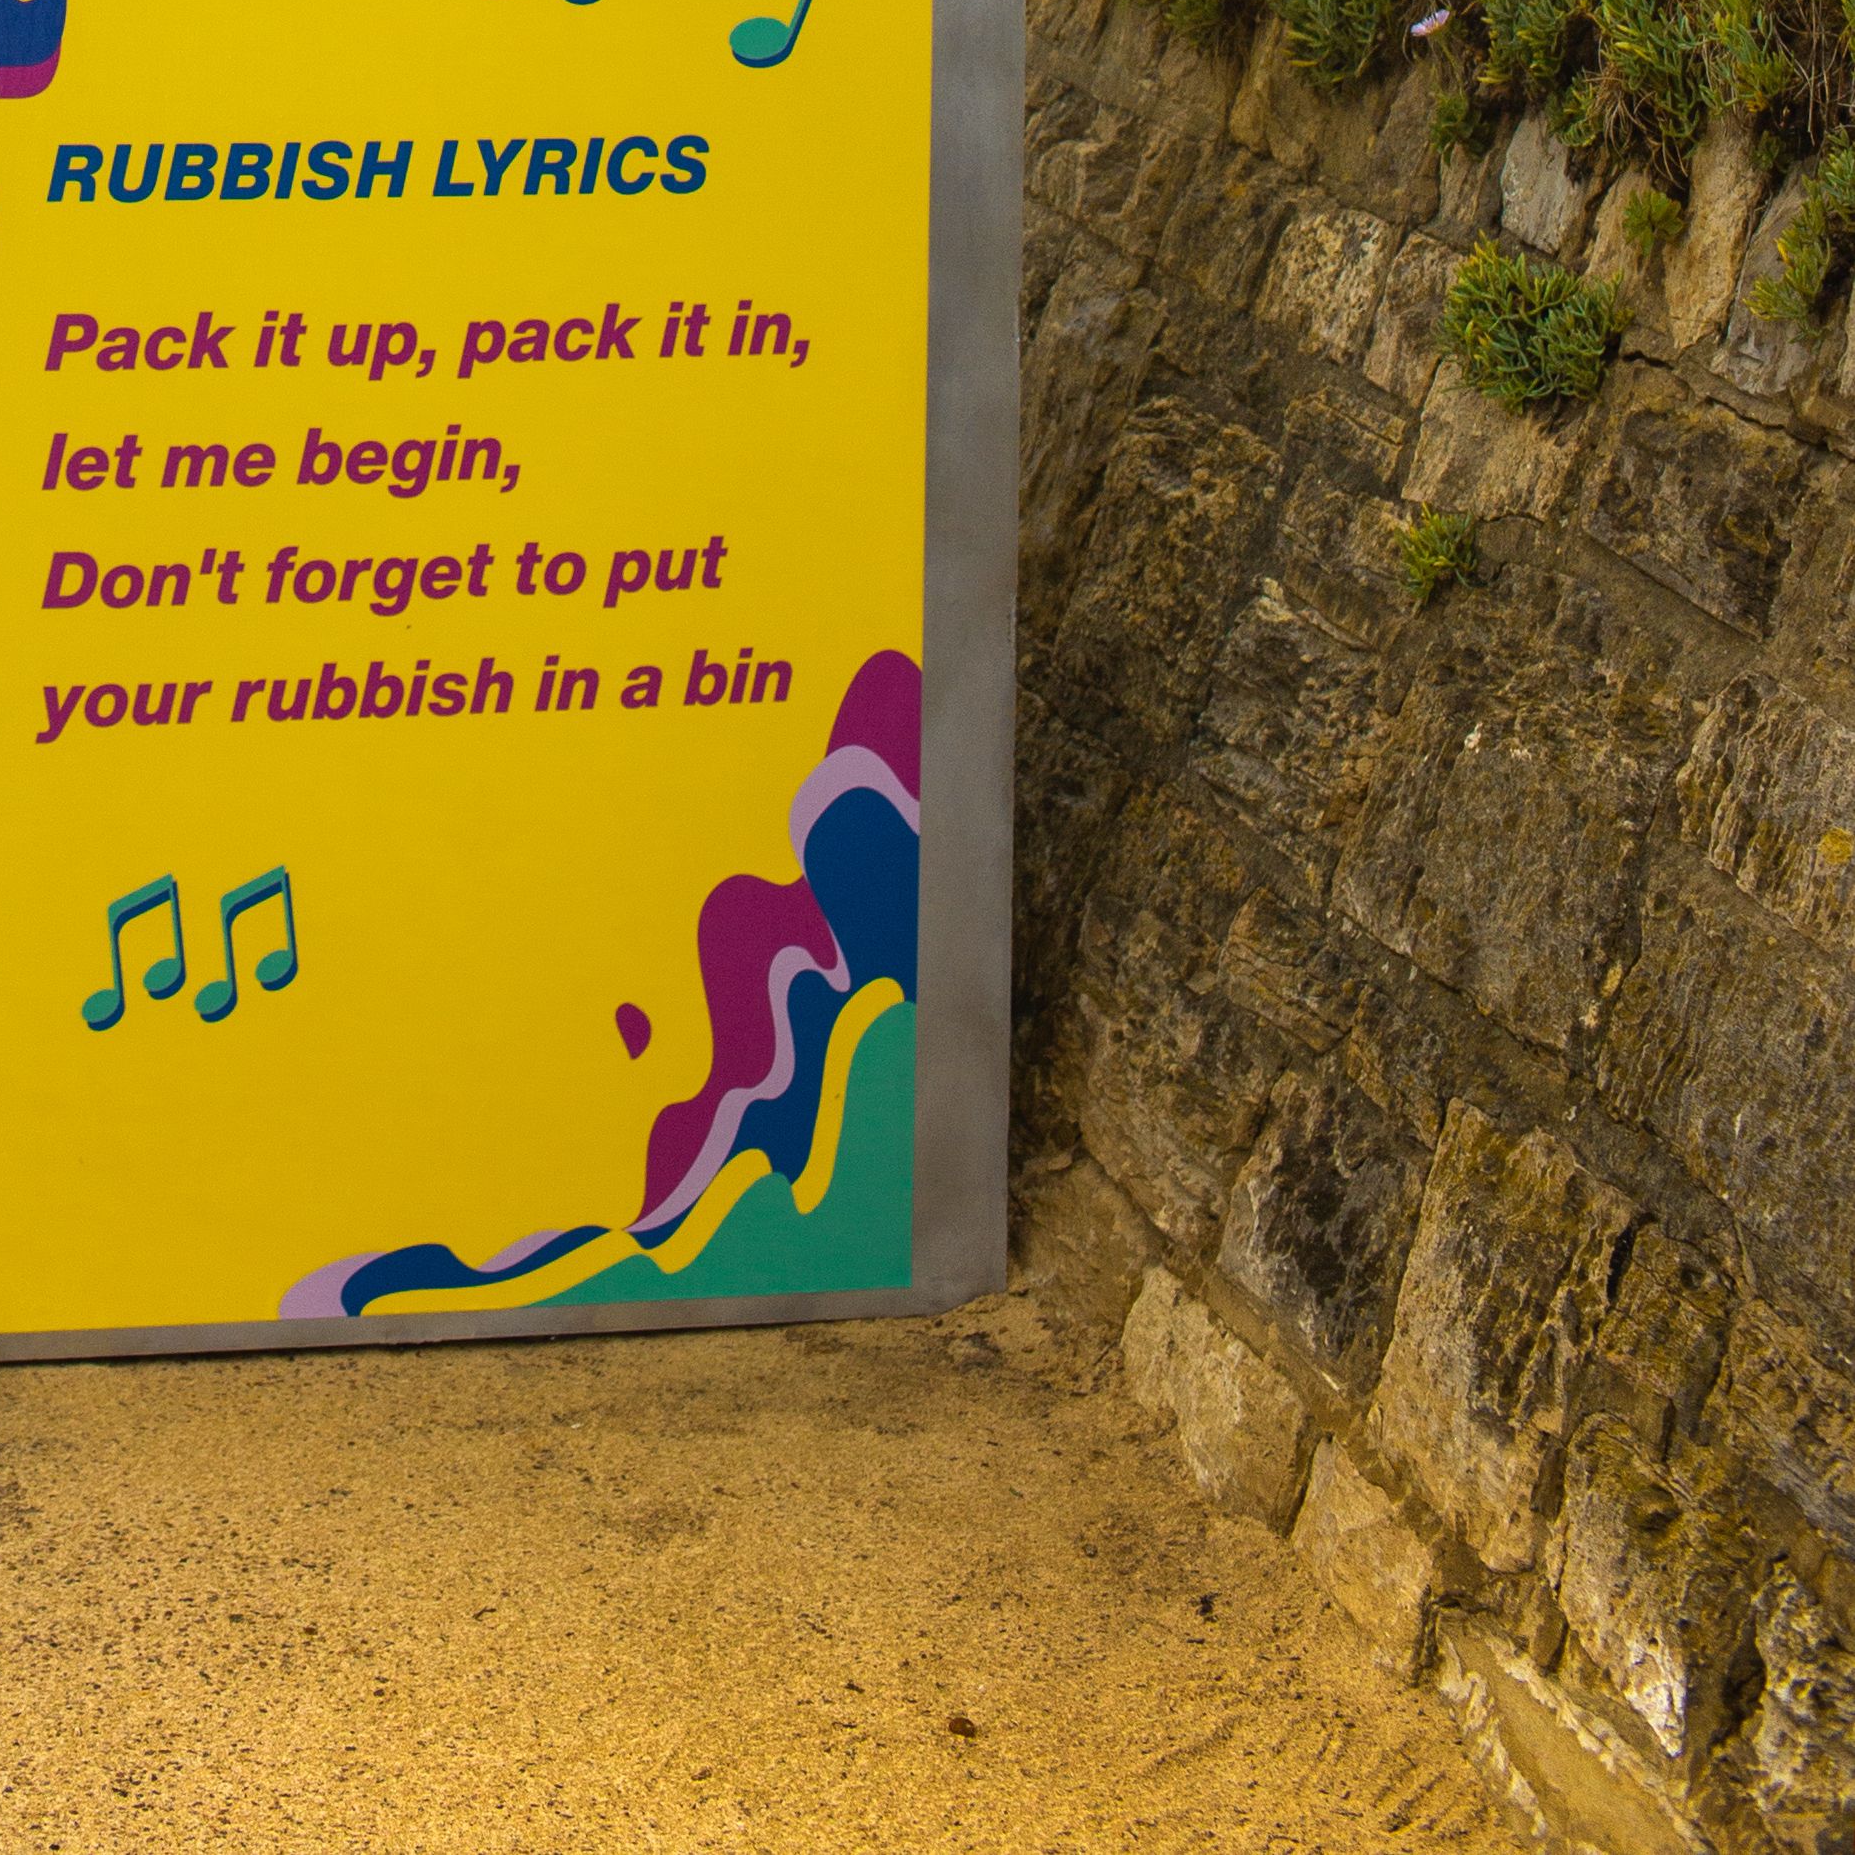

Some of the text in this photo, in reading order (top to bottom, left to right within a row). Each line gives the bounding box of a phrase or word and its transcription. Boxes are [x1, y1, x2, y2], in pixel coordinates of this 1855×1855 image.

[47, 135, 709, 203] RUBBISH LYRICS
[45, 301, 810, 381] Pack it up, pack it in,
[42, 427, 520, 499] let me begin,
[42, 535, 728, 617] Don't forget to put
[35, 647, 793, 744] your rubbish in a bin
